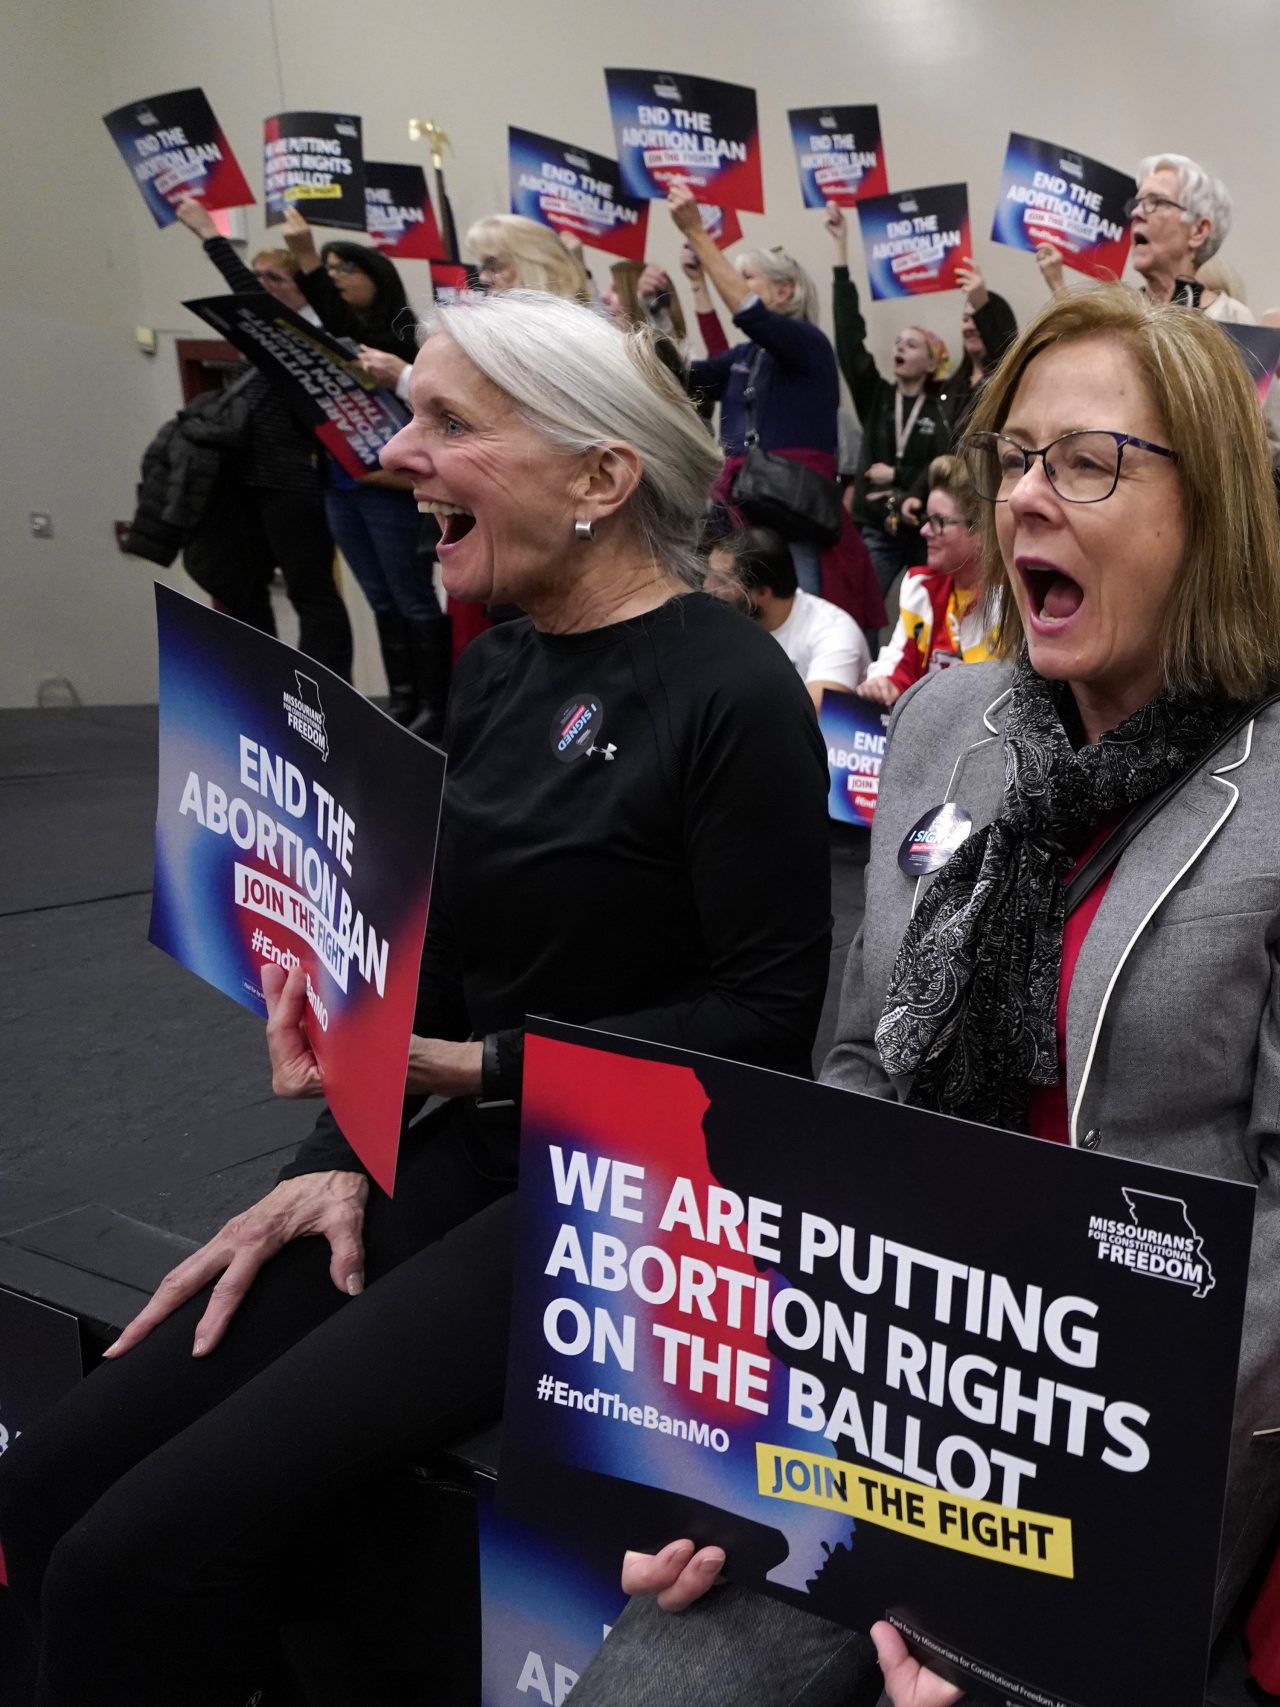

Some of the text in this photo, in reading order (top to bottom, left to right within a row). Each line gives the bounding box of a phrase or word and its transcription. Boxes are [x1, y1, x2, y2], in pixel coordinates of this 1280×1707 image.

[638, 105, 712, 133] END THE
[622, 127, 747, 162] ABORTION BAN
[541, 161, 614, 200] END THE
[1033, 170, 1104, 212] END THE
[603, 199, 639, 225] BAN
[886, 214, 939, 240] END THE
[1006, 184, 1087, 224] ABORTION
[1086, 213, 1124, 243] BAN
[932, 230, 961, 249] BAN
[283, 691, 323, 725] MISSOURIANS
[590, 703, 598, 712] I
[287, 712, 326, 750] FREEDOM
[557, 709, 593, 752] SIGNED
[828, 747, 882, 776] ABORT
[239, 733, 356, 878] END THE
[908, 830, 917, 842] I
[178, 770, 390, 999] ABORTION BAN
[242, 873, 346, 977] JOIN THE FIGHT
[1088, 1229, 1193, 1263] FOR CONSTITUTIONAL
[1089, 1215, 1194, 1252] MISSOURIANS
[549, 1145, 1100, 1369] WE ARE PUTTING
[1097, 1241, 1203, 1284] FREEDOM
[544, 1223, 1151, 1472] ABORTION RIGHTS
[536, 1374, 730, 1454] #EndTheBanMO
[543, 1297, 1037, 1509] ON THE BALLOT
[771, 1455, 1054, 1561] JOIN THE FIGHT
